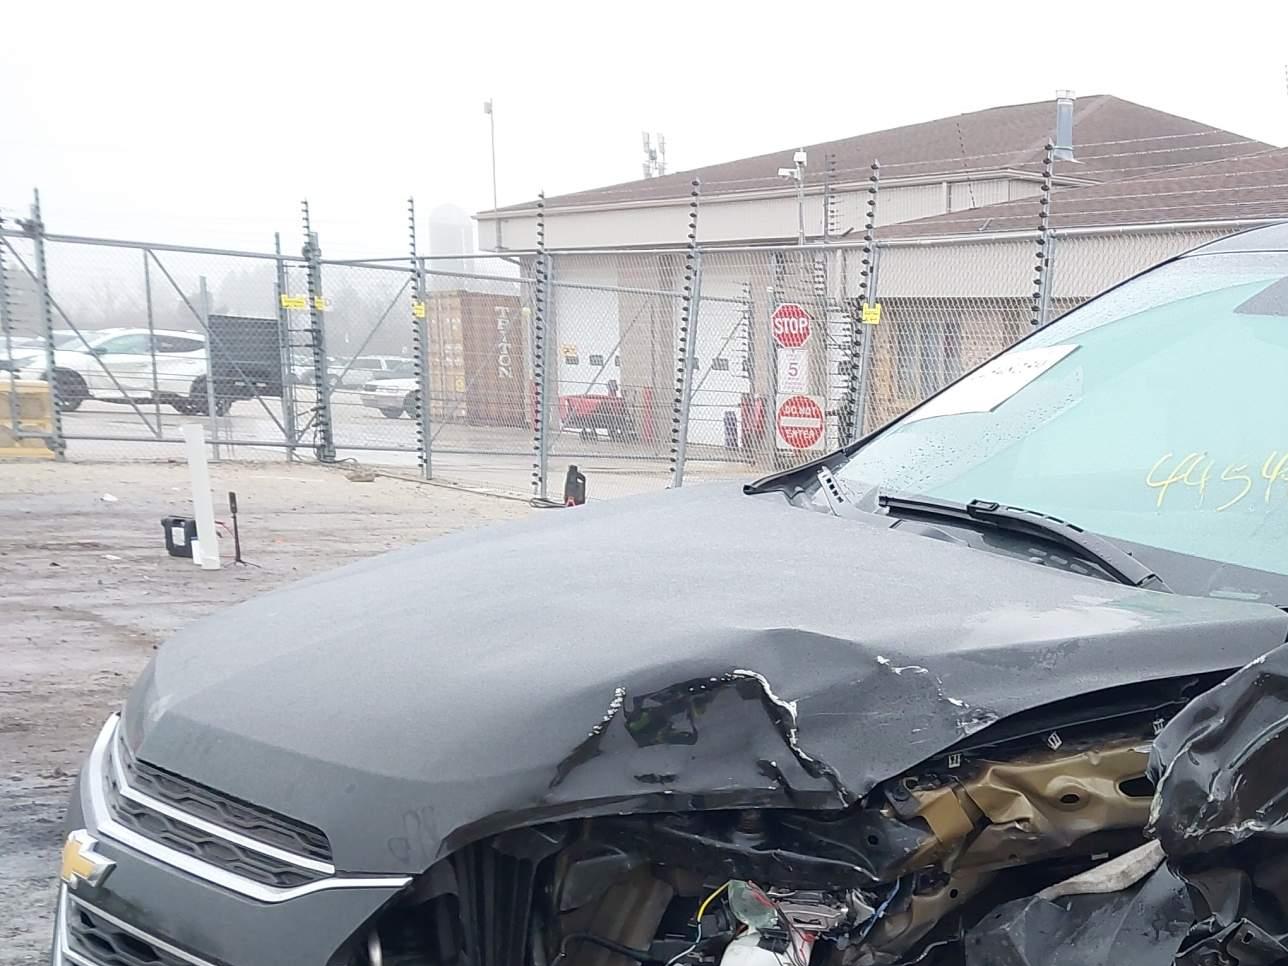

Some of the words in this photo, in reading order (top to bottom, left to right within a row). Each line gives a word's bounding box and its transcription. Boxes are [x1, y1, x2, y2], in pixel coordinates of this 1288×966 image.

[774, 317, 808, 334] STOP
[787, 362, 799, 377] 5
[784, 405, 798, 415] DO
[799, 405, 818, 416] NOT
[785, 429, 816, 439] ENTER
